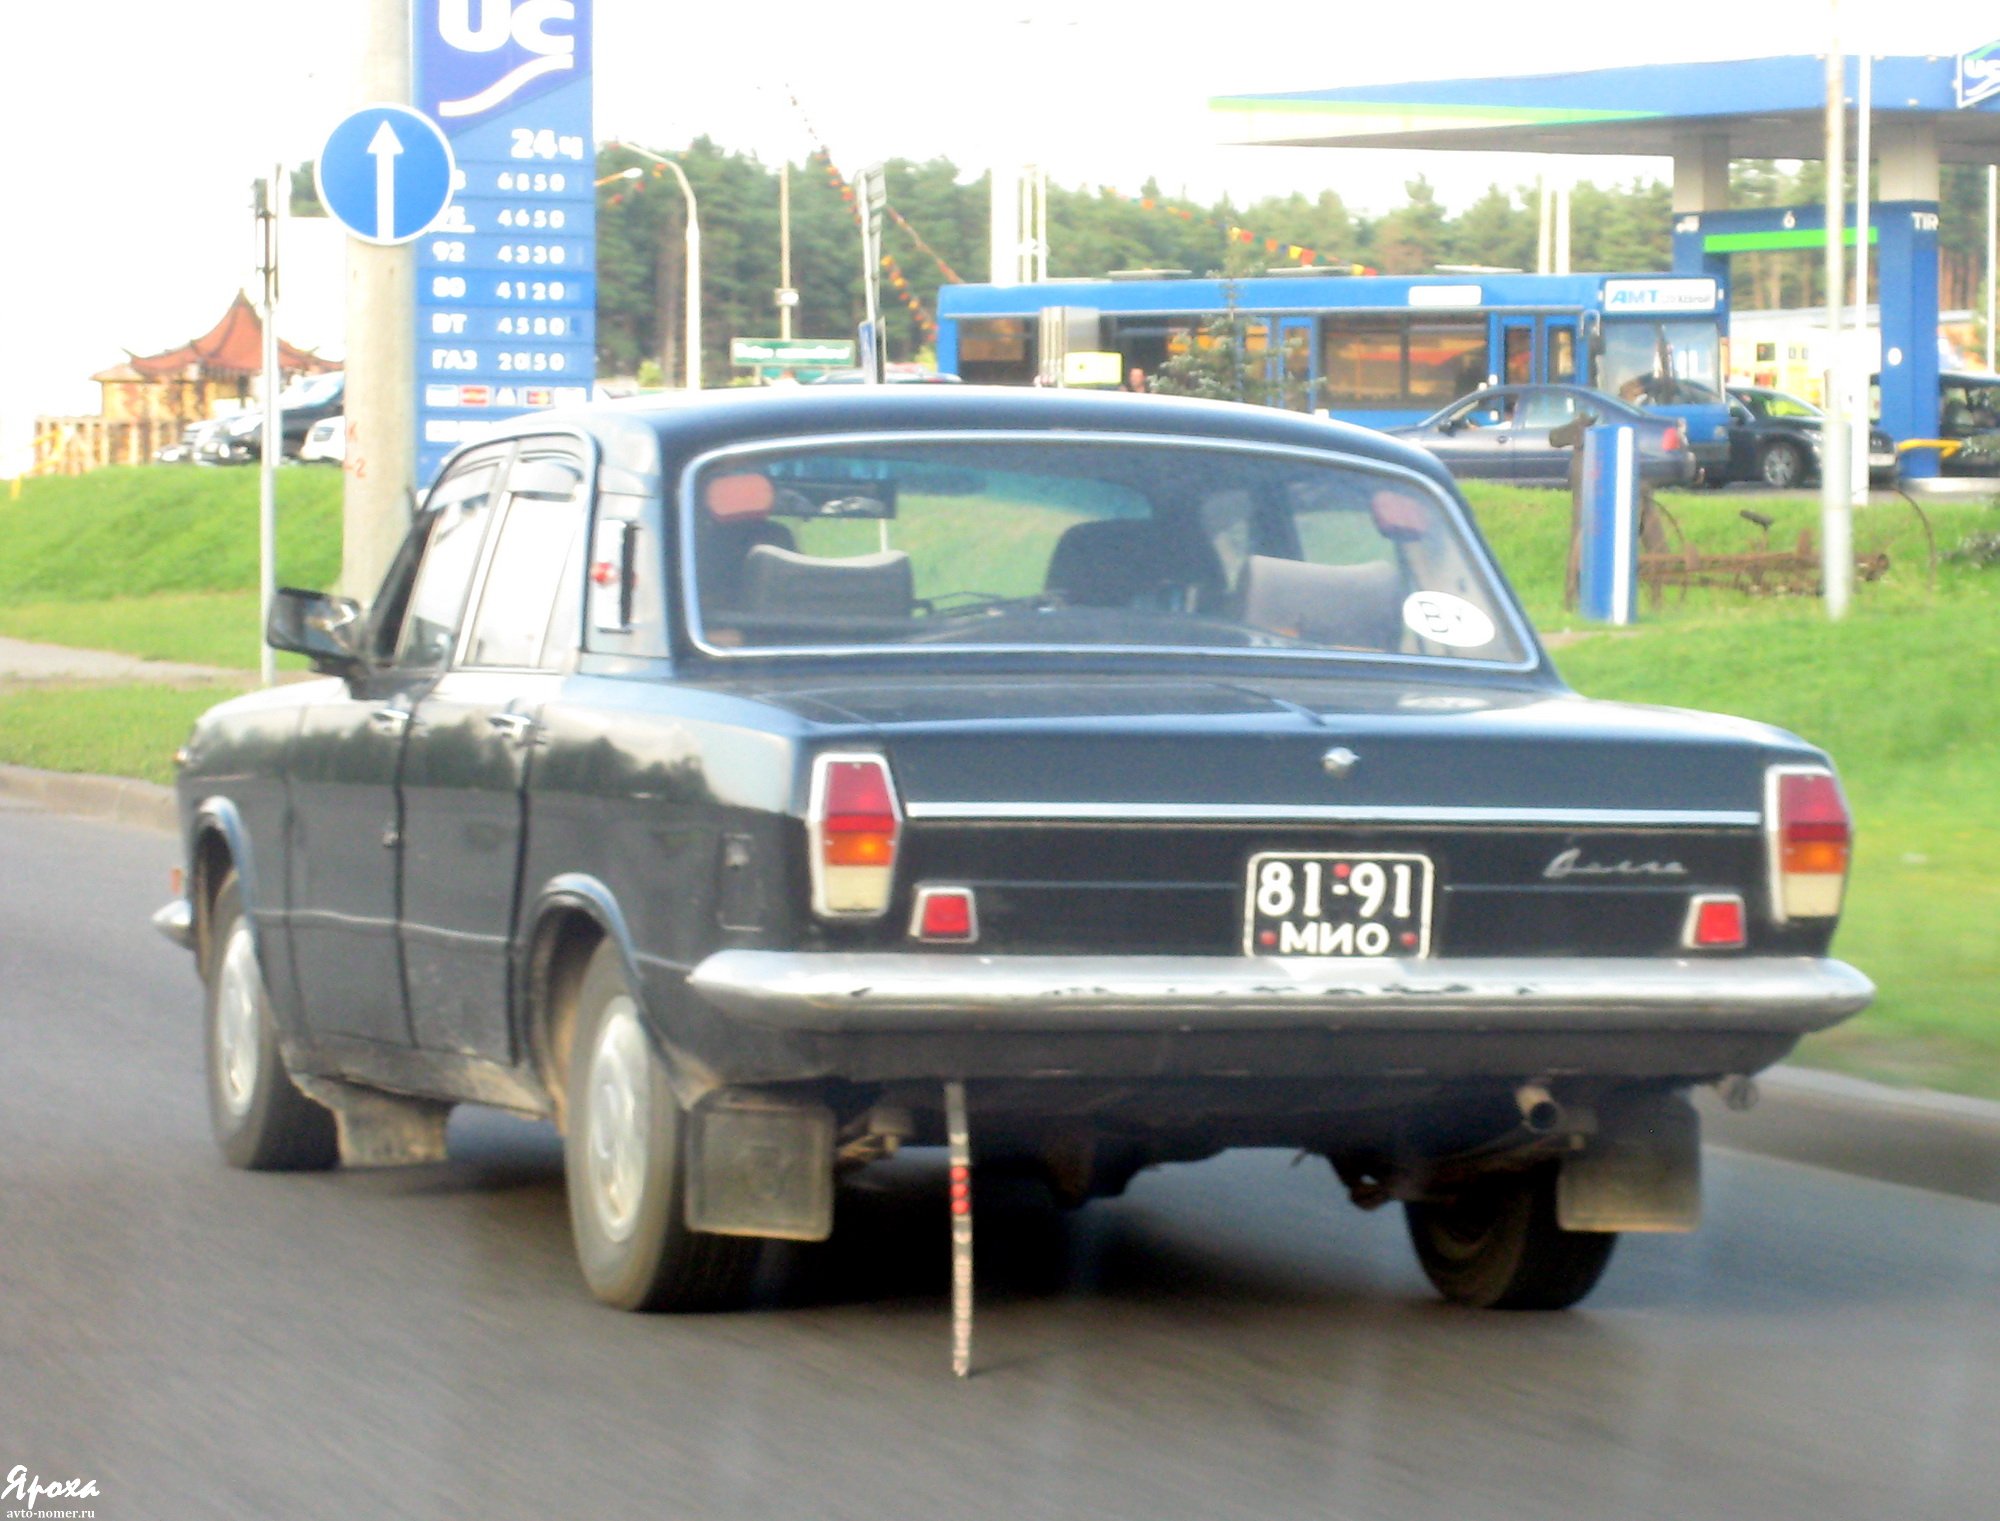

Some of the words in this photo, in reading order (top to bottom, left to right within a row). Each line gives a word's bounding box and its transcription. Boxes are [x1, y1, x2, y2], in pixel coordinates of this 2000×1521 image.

[1910, 211, 1940, 231] TIR
[432, 349, 478, 370] ГАЗ
[1257, 861, 1412, 918] 81-91
[1280, 921, 1390, 955] МИО
